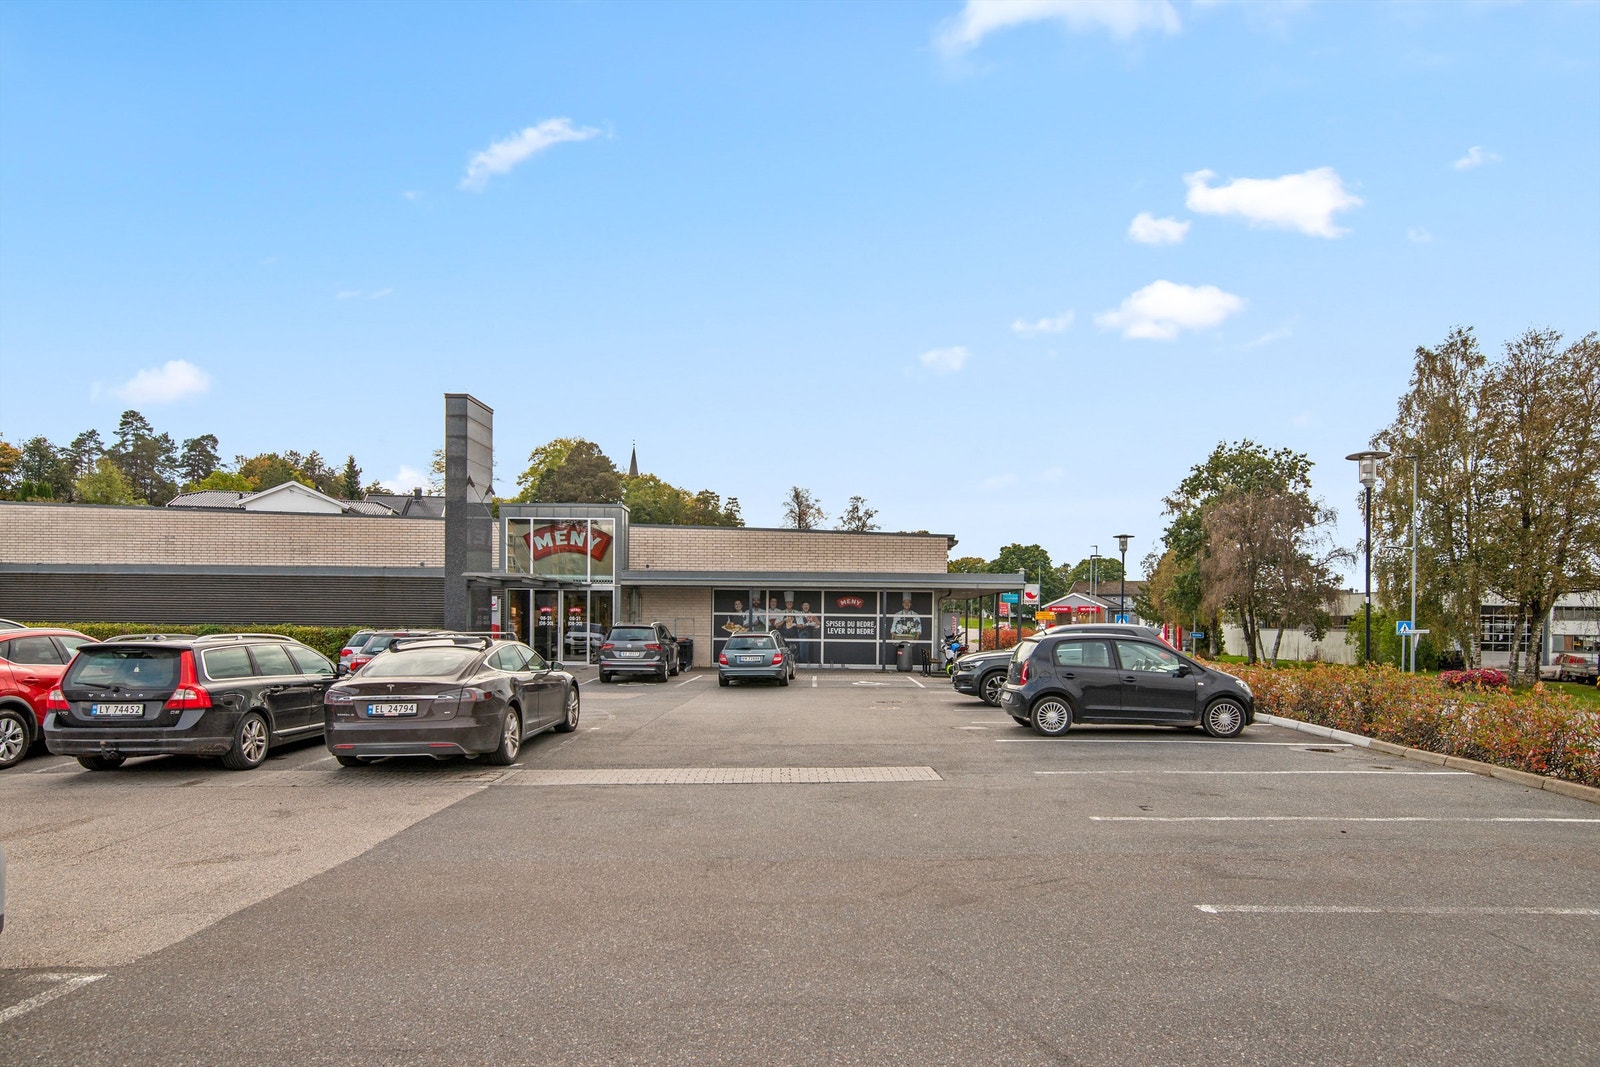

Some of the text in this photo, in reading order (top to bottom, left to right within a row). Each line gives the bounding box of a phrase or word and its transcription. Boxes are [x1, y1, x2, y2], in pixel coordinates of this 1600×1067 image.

[533, 530, 602, 551] MENY
[840, 598, 862, 606] MENY
[856, 620, 877, 629] BEDRE,
[99, 705, 141, 714] LY 74452
[375, 704, 414, 713] EL 24794
